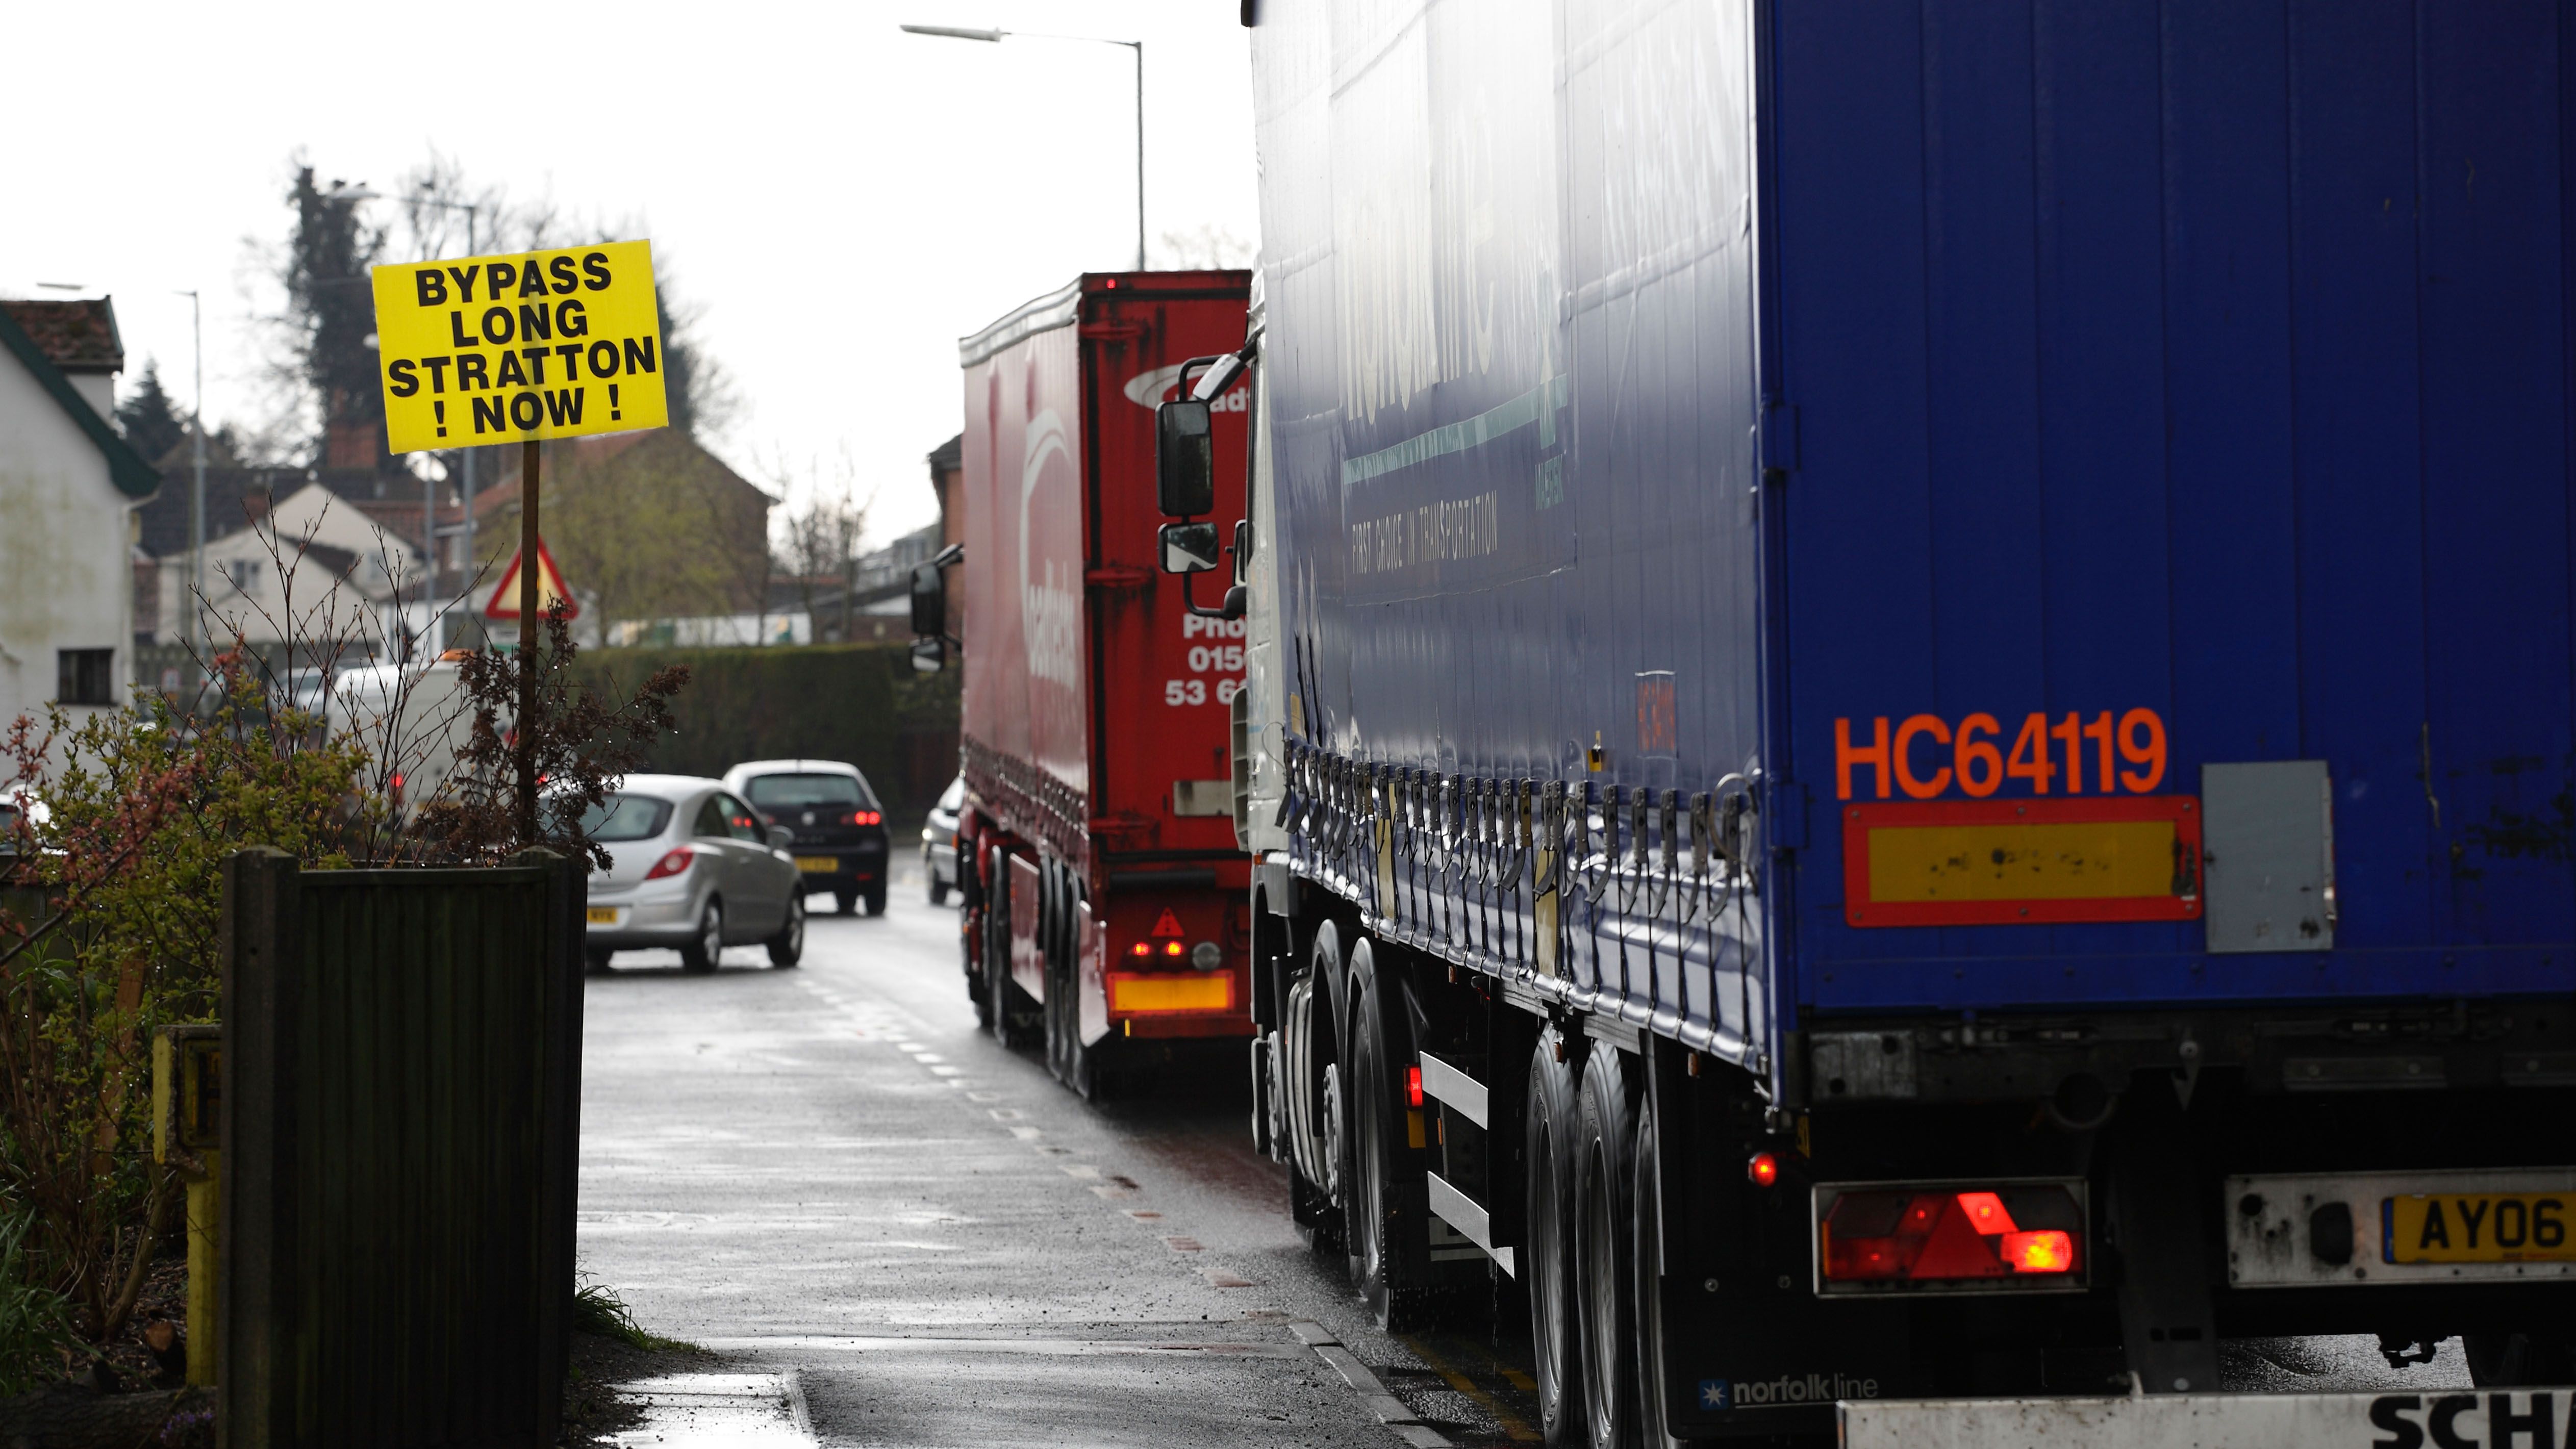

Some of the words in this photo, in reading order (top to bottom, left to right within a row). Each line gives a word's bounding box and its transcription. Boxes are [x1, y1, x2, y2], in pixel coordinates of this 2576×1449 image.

[416, 253, 611, 307] BYPASS
[451, 299, 588, 347] LONG
[389, 336, 655, 397] STRATTON
[434, 401, 447, 437] !
[472, 387, 584, 434] NOW
[608, 384, 621, 421] !
[1352, 521, 1371, 574] FIRST
[1377, 513, 1402, 573] CHOICE
[1407, 511, 1415, 565] IN
[1420, 490, 1497, 563] TRANSPORTATION
[1183, 613, 1246, 638] Pho
[1188, 646, 1246, 672] 015
[1165, 679, 1206, 706] 53
[1217, 679, 1247, 705] 6
[1836, 707, 2167, 800] HC64119
[2419, 1199, 2565, 1249] AY06
[2369, 1395, 2576, 1449] SCH
